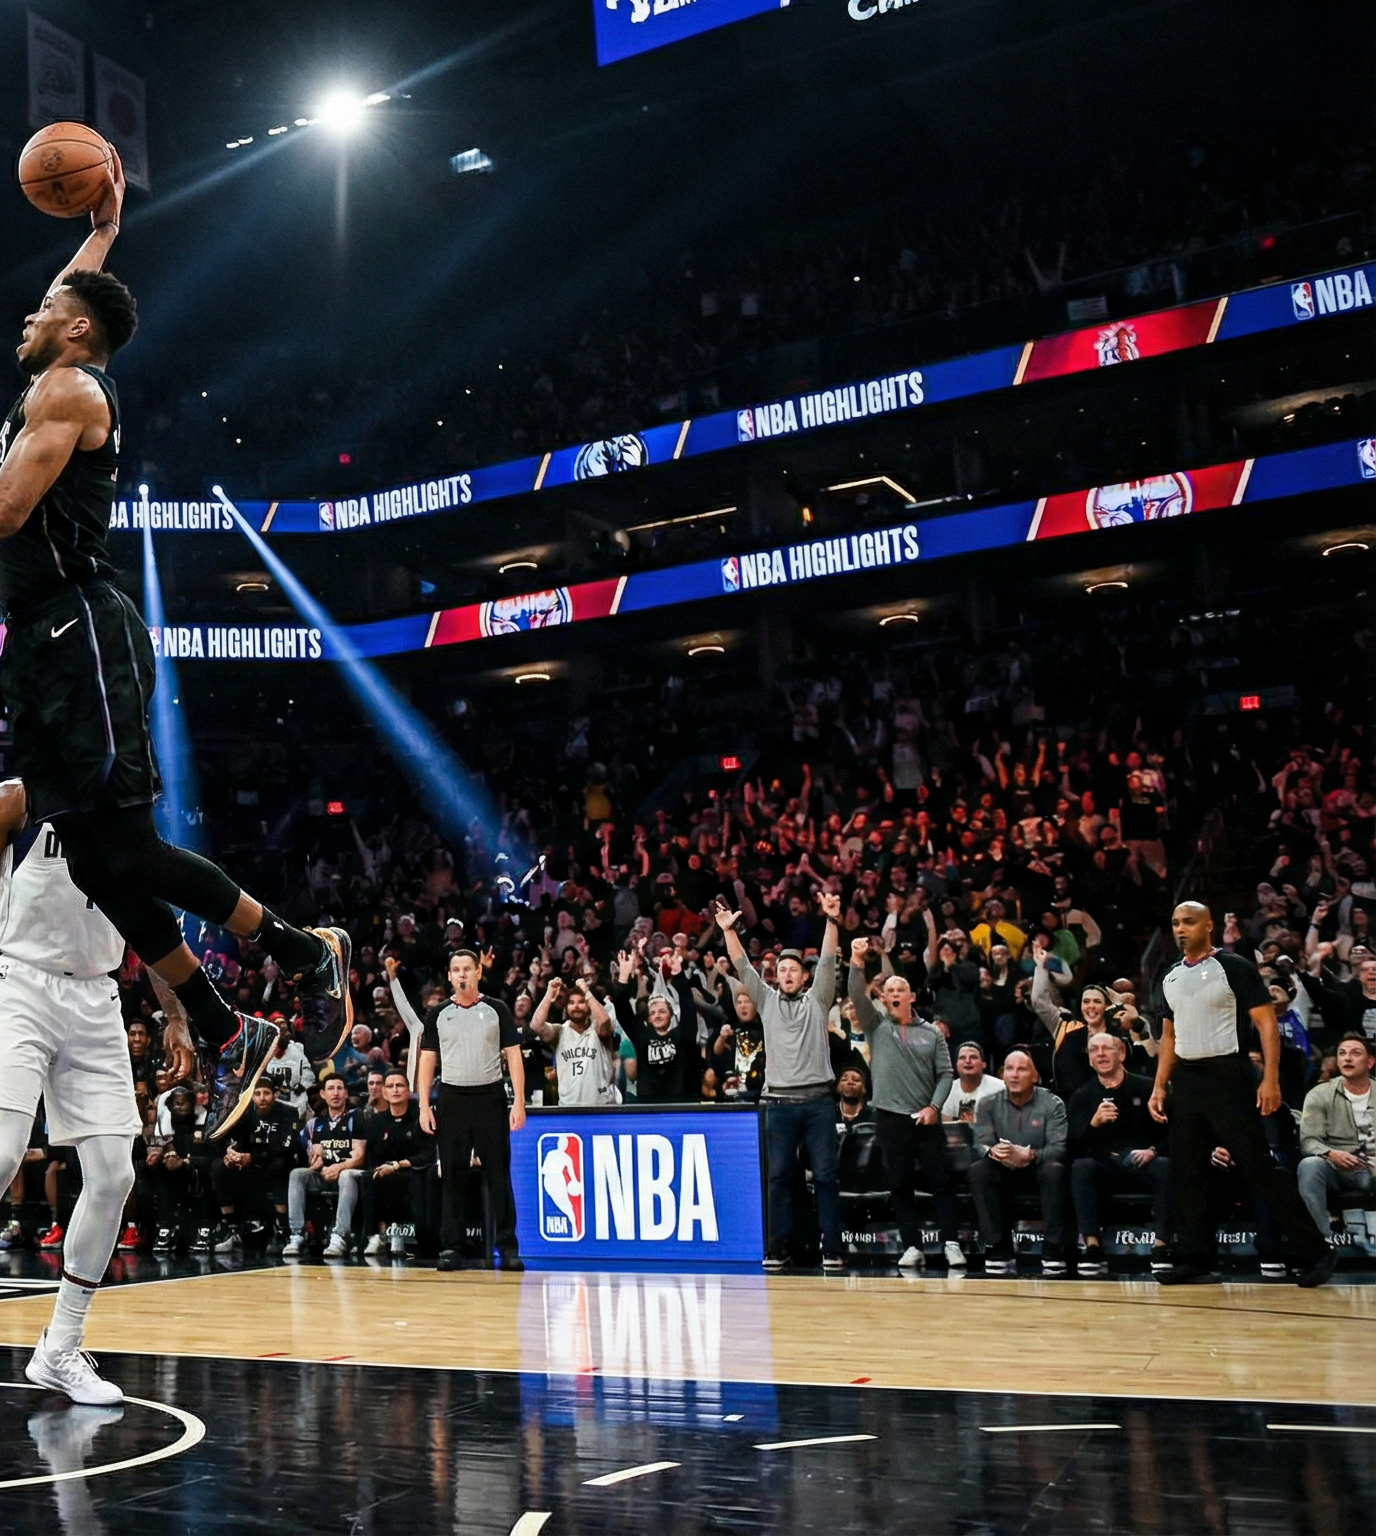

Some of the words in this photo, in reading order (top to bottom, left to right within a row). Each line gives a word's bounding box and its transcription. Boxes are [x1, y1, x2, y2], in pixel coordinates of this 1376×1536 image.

[1314, 271, 1373, 315] NBA
[754, 400, 799, 438] NBA
[799, 371, 924, 429] HIGHLIGHTS
[132, 501, 234, 530] HIGHLIGHTS
[334, 496, 371, 530] NBA
[373, 473, 472, 523] HIGHLIGHTS
[740, 549, 787, 589] NBA
[788, 525, 920, 580] HIGHLIGHTS
[163, 627, 205, 658] NBA
[207, 627, 322, 659] HIGHLIGHTS
[592, 1133, 719, 1242] NBA
[546, 1215, 569, 1234] NBA
